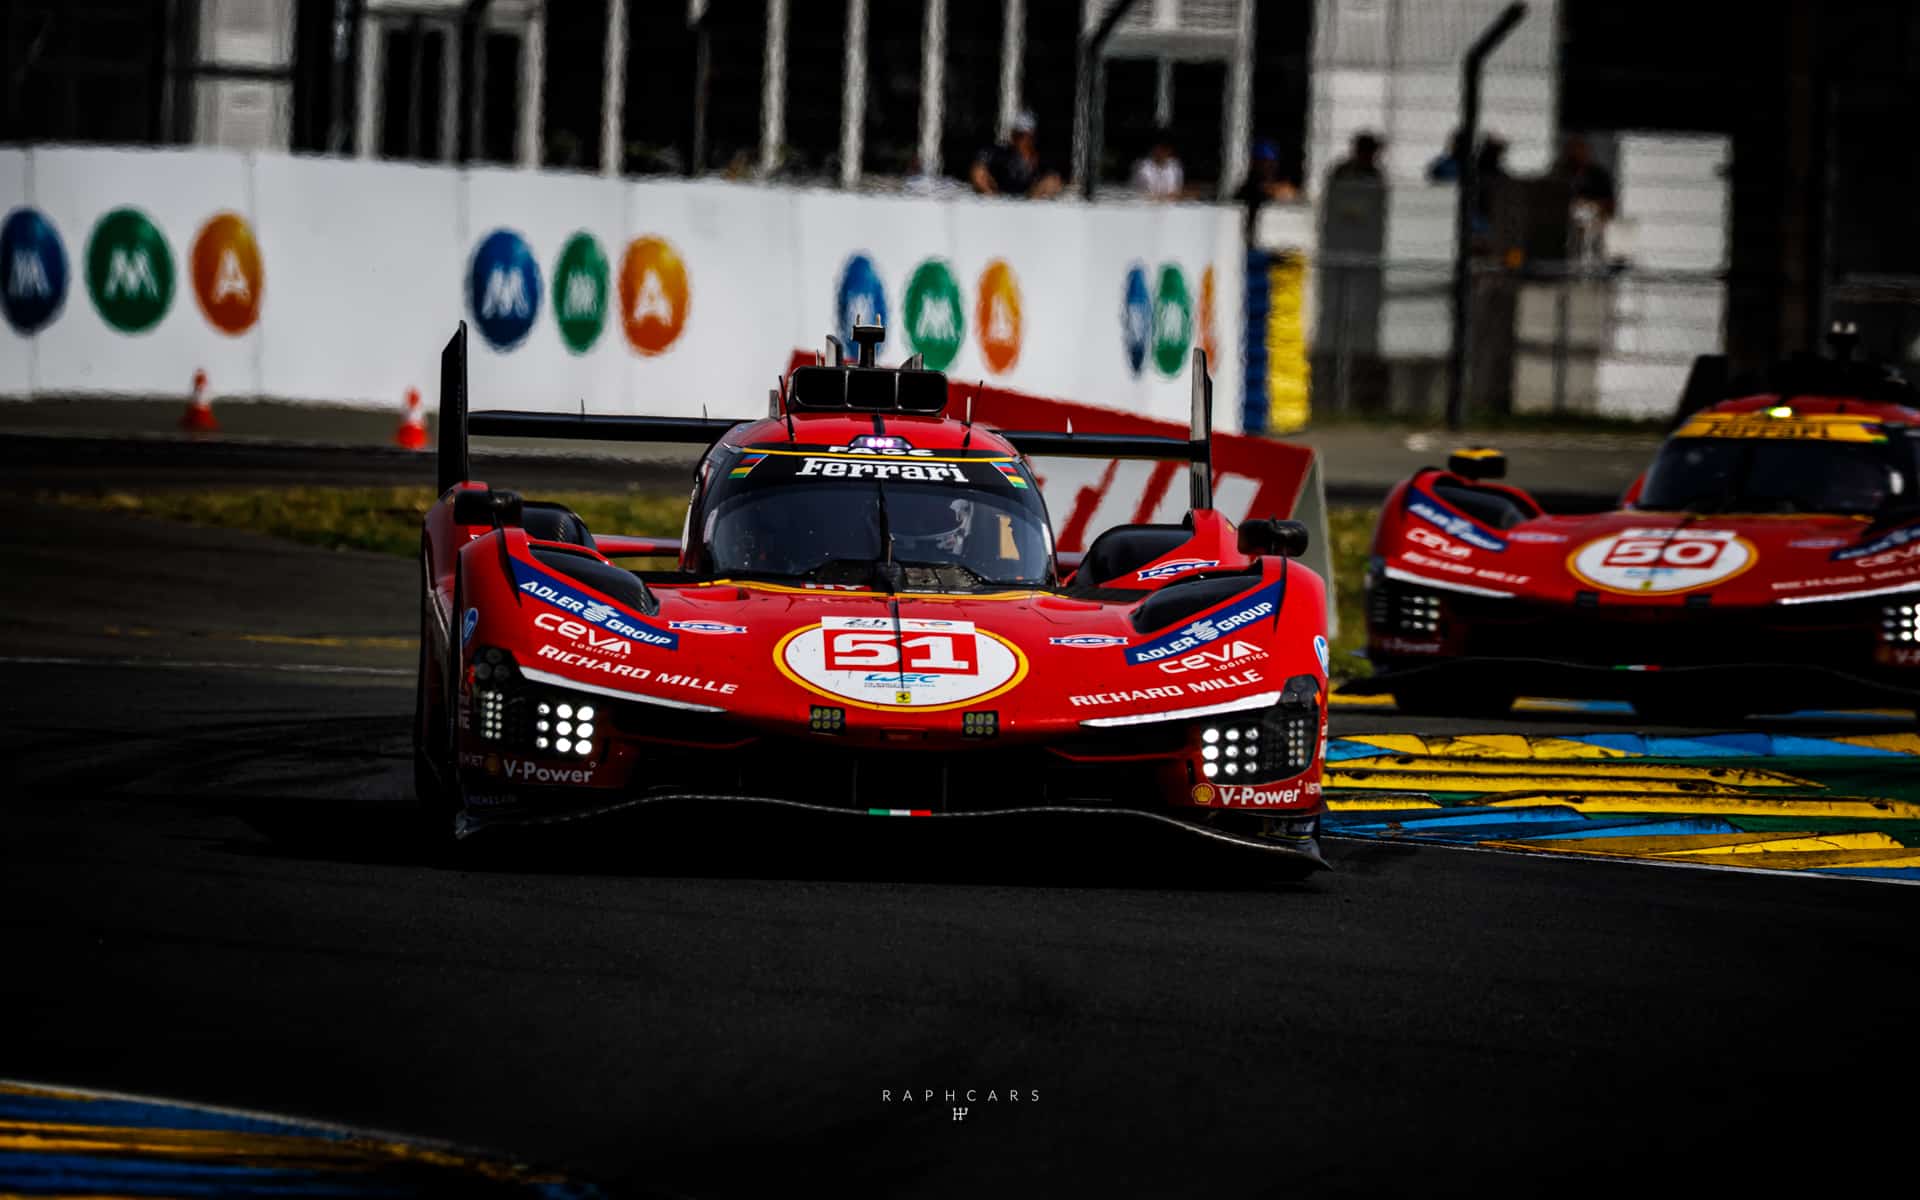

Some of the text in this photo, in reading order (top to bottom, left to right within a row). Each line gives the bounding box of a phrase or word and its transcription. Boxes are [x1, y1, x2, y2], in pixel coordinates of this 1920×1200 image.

[104, 248, 160, 299] M
[211, 250, 252, 305] A
[481, 267, 529, 319] M
[633, 267, 673, 326] A
[916, 294, 957, 341] M
[988, 295, 1016, 342] A
[795, 457, 969, 483] Ferrari
[1605, 541, 1720, 566] 50
[519, 581, 673, 645] ADLER GROUP
[1136, 602, 1273, 662] ADLER GROUP
[537, 643, 739, 695] RICHARD MILLE
[833, 633, 969, 670] 51
[1068, 669, 1264, 707] RICHARD MILLE
[502, 759, 594, 784] V-Power
[1219, 786, 1301, 807] V-Power
